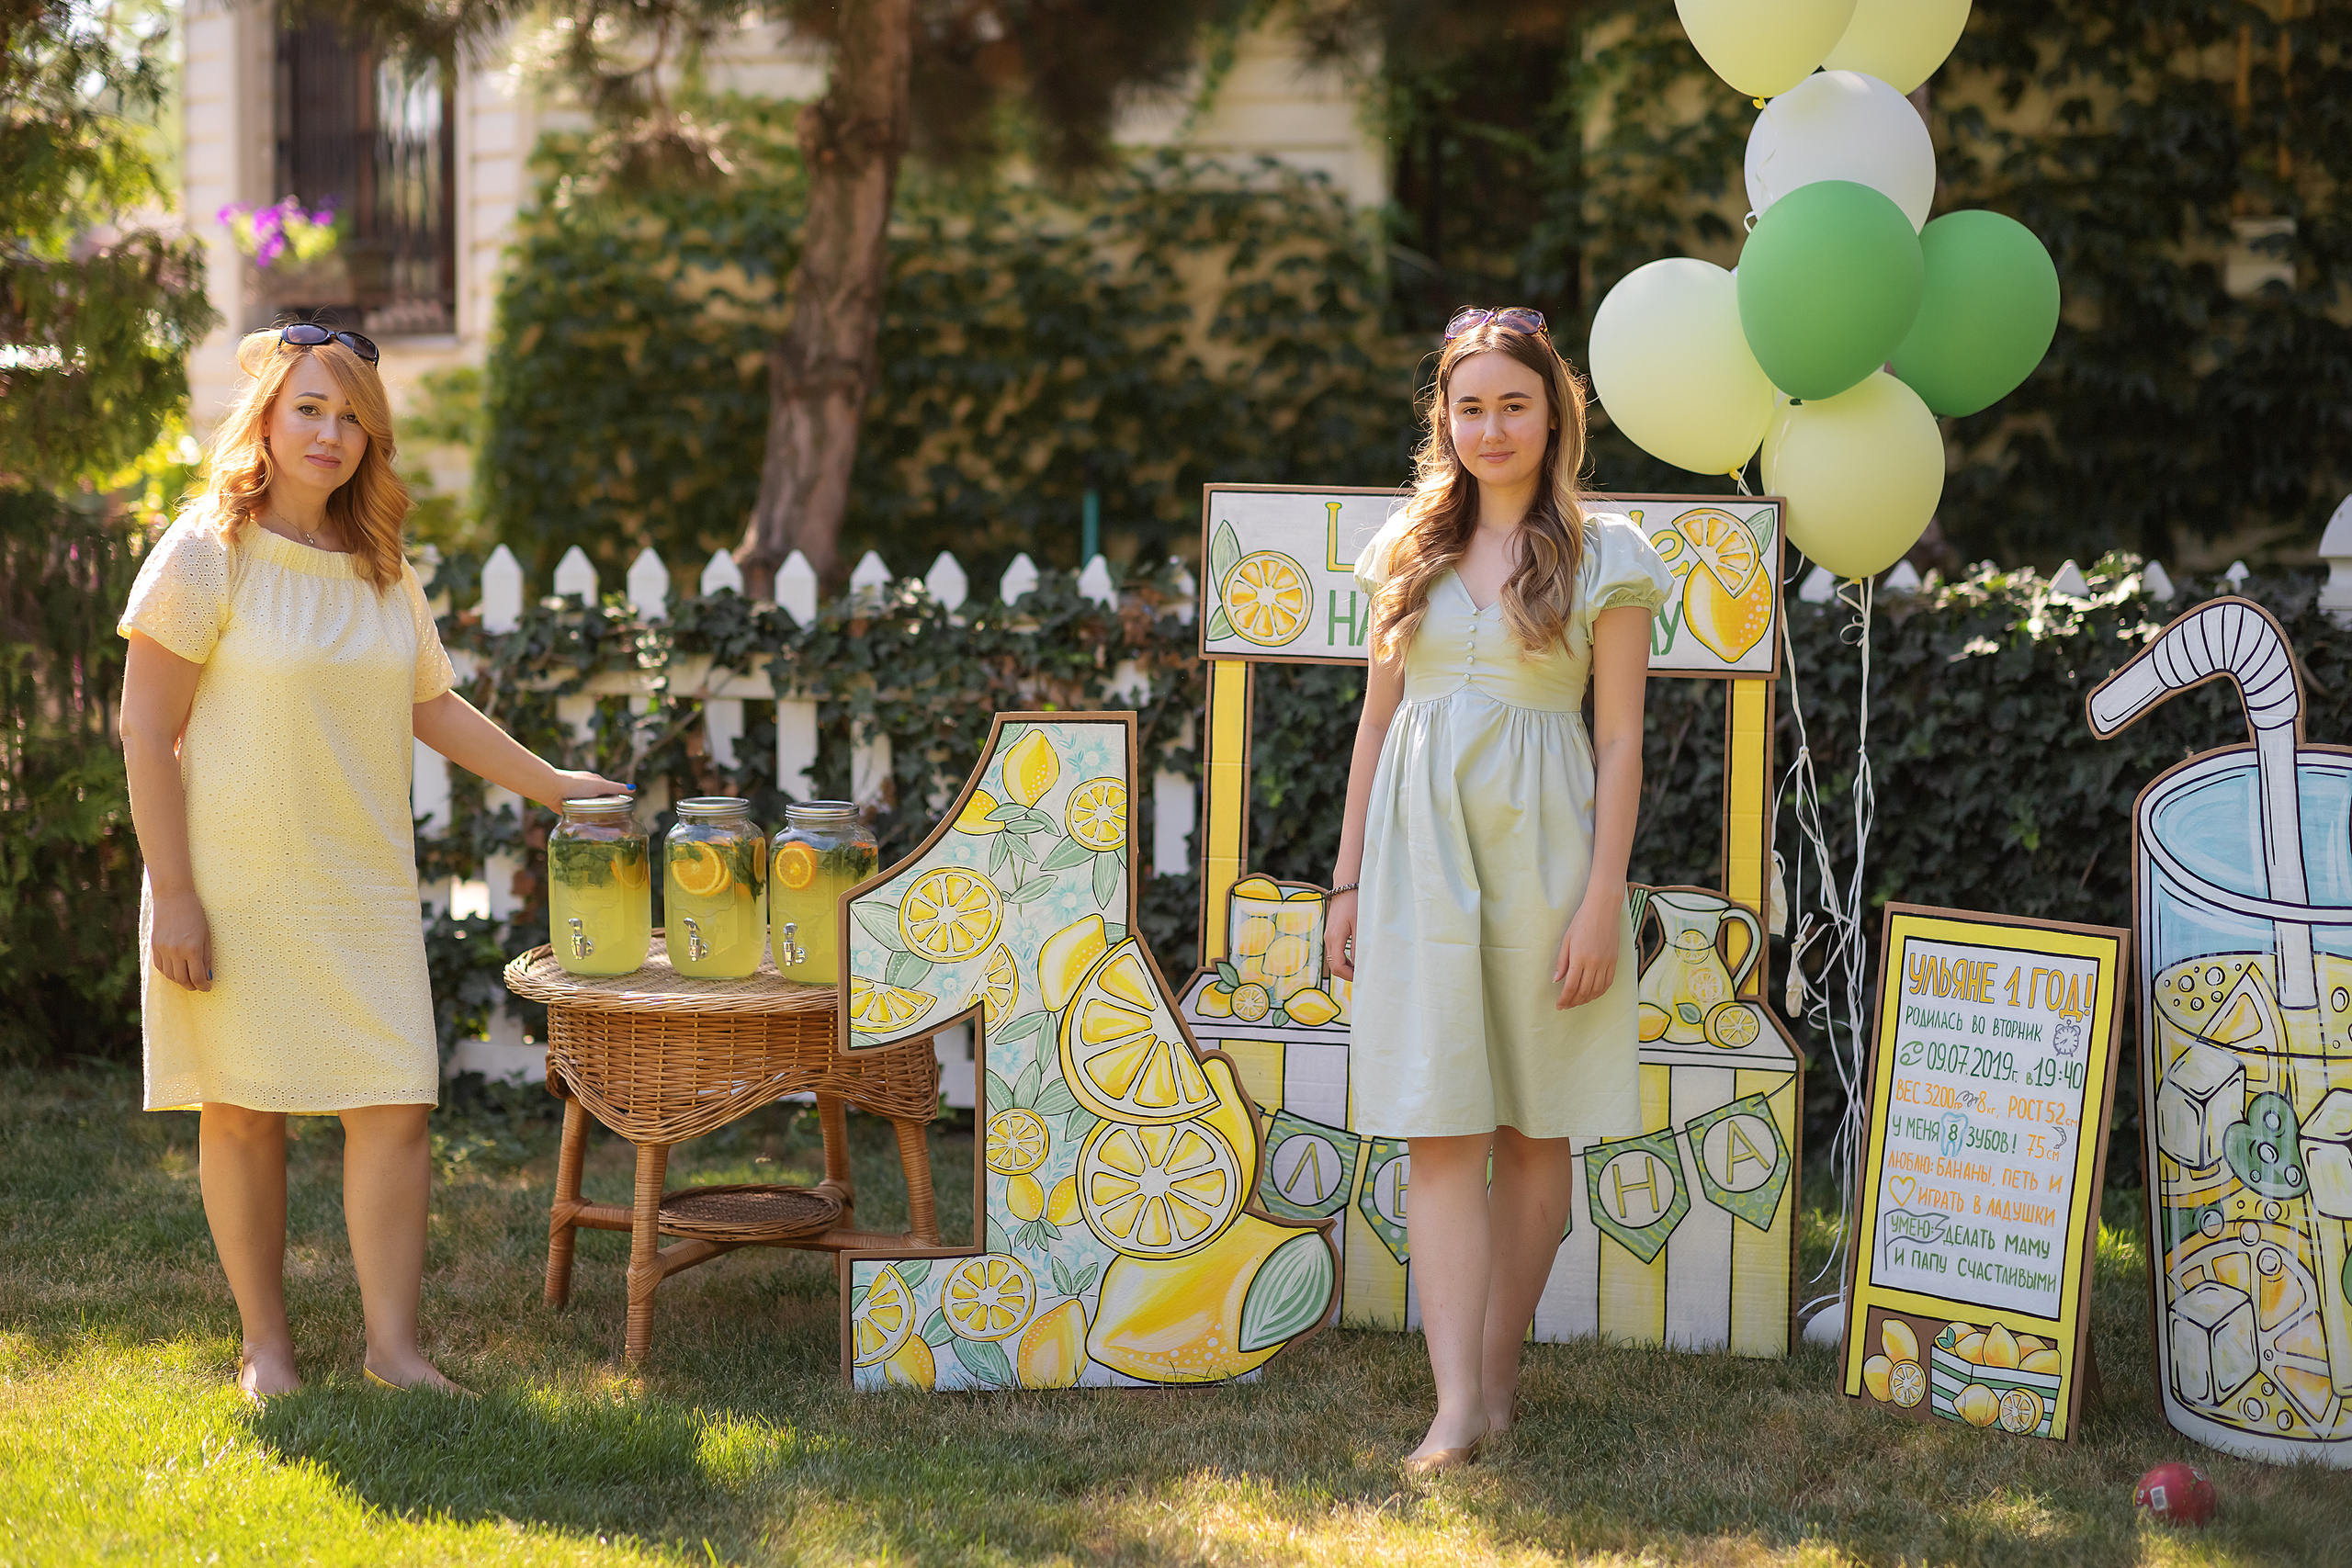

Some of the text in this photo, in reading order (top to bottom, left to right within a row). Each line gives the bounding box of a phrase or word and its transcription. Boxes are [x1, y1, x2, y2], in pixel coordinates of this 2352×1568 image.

[1909, 952, 2094, 1022] УЛЬЯНЕ 1 ГОД!
[1905, 1006, 2042, 1043] РОДИЛАСЬ ВО ВТОРНИК
[1895, 1078, 1920, 1104] ВЕС
[2007, 1095, 2043, 1122] РОСТ
[1905, 1118, 1939, 1143] МЕНЯ
[1948, 1123, 1959, 1142] 8
[2002, 1168, 2039, 1191] ПЕТЬ
[2049, 1174, 2064, 1194] И
[1917, 1186, 1964, 1213] ИГРАТЬ
[1985, 1197, 2056, 1227] ЛАДУШКИ
[1943, 1224, 1996, 1250] ДЕЛАТЬ
[2005, 1234, 2051, 1259] МАМУ
[1894, 1247, 2057, 1293] И ПАПУ СЧАСТЛИВЫМИ
